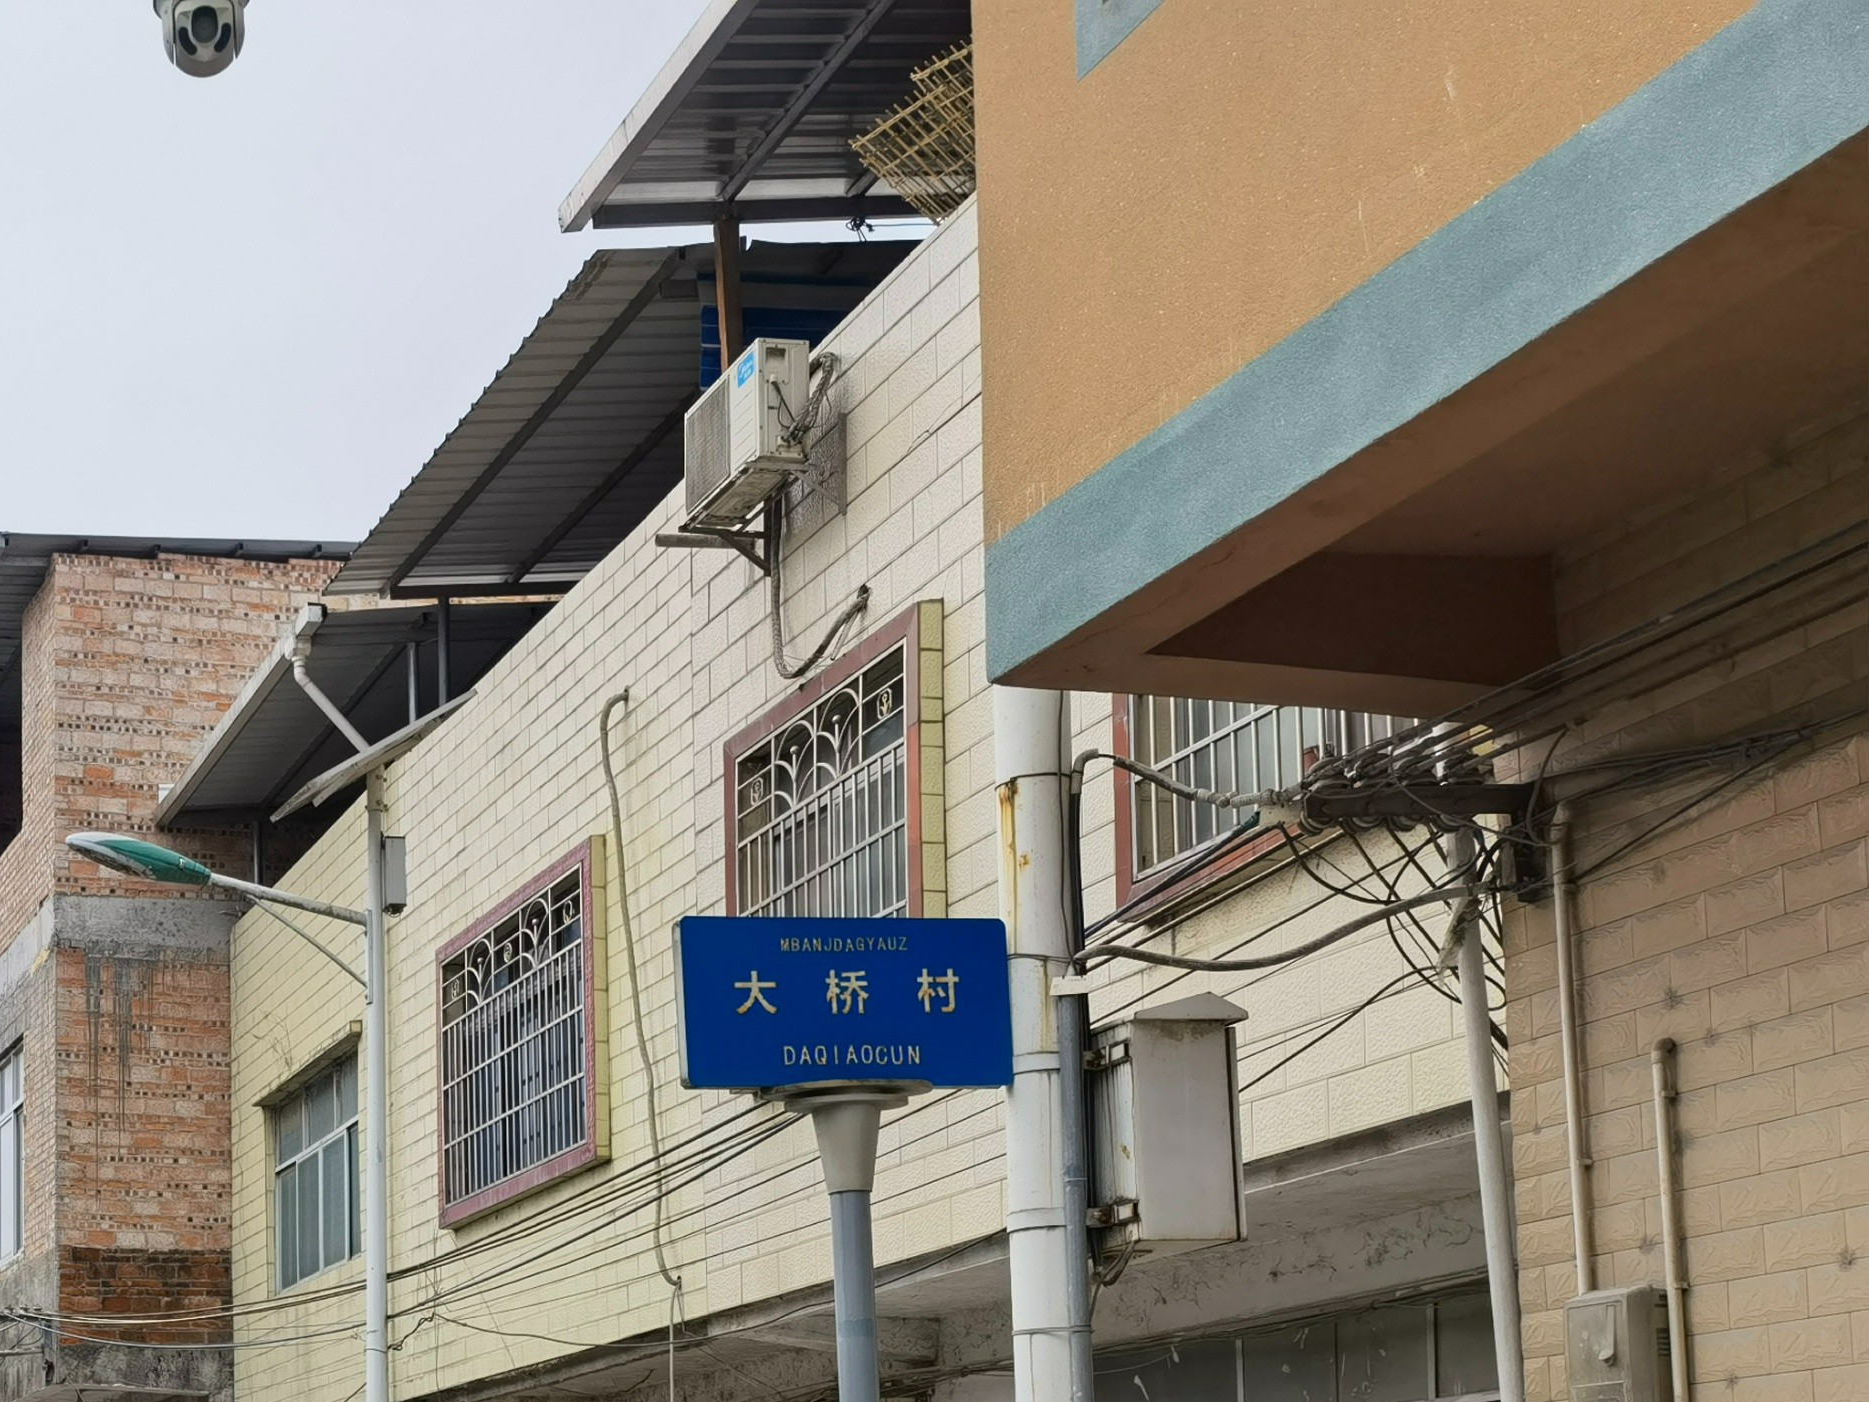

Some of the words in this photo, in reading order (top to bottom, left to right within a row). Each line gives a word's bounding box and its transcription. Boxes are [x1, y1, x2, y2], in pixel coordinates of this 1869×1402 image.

[780, 936, 909, 952] MBANJDAGYAUZ
[734, 968, 960, 1014] 大桥村
[783, 1045, 921, 1065] DAQIAOCUN
